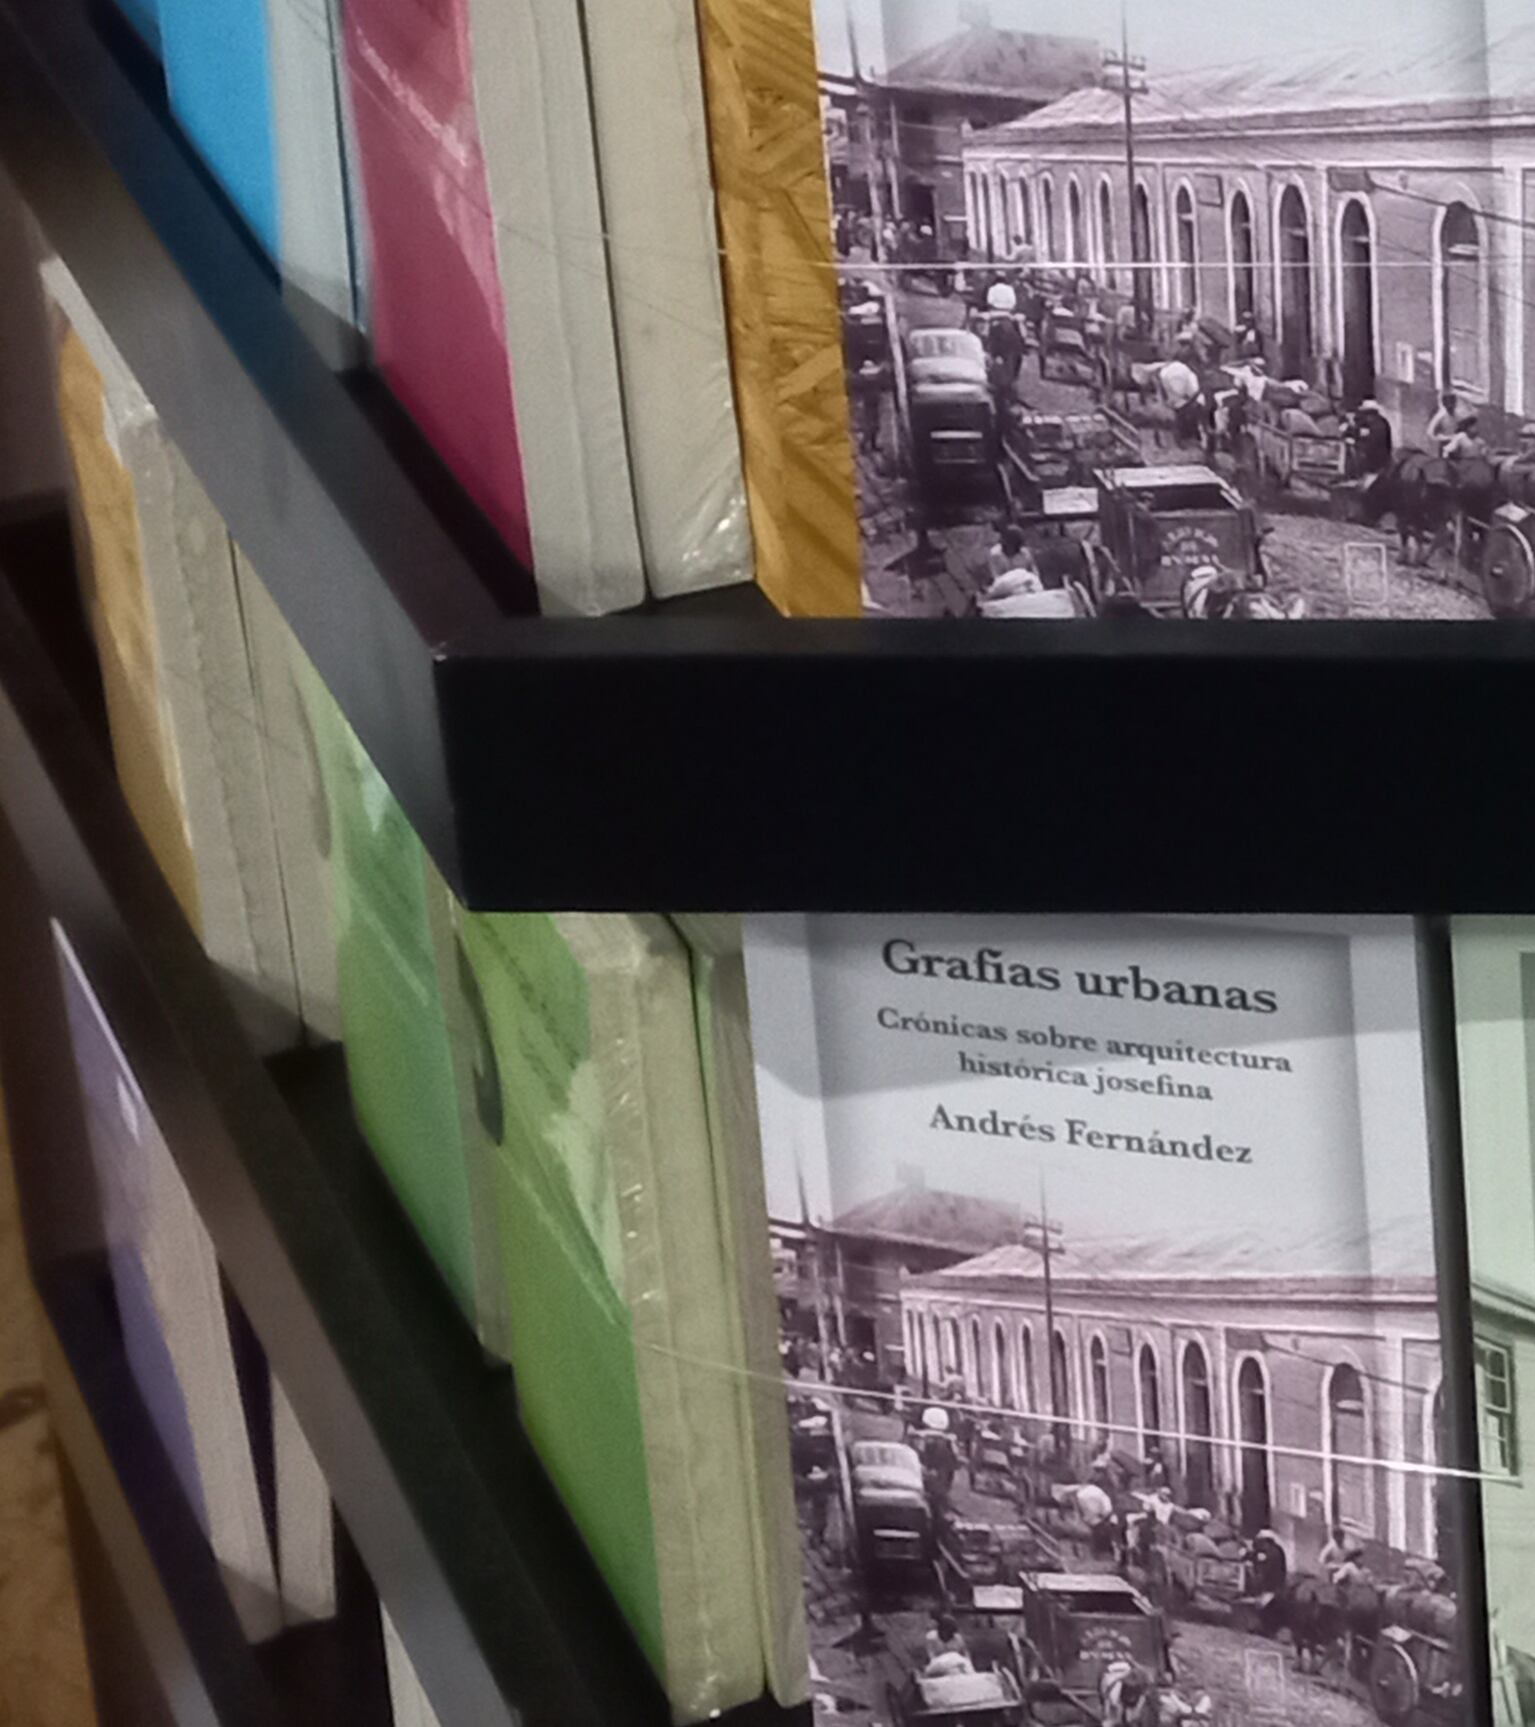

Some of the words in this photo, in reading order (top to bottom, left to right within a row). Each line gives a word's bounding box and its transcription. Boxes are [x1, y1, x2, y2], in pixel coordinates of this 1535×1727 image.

[1075, 965, 1278, 1014] urbanas
[877, 1007, 1009, 1042] Crónicas
[1015, 1025, 1097, 1052] sobre
[1106, 1039, 1292, 1073] arquitectura
[957, 1050, 1089, 1087] histórica
[1093, 1074, 1214, 1101] josefina
[930, 1104, 1056, 1142] Andrés
[1065, 1118, 1253, 1164] Fernández
